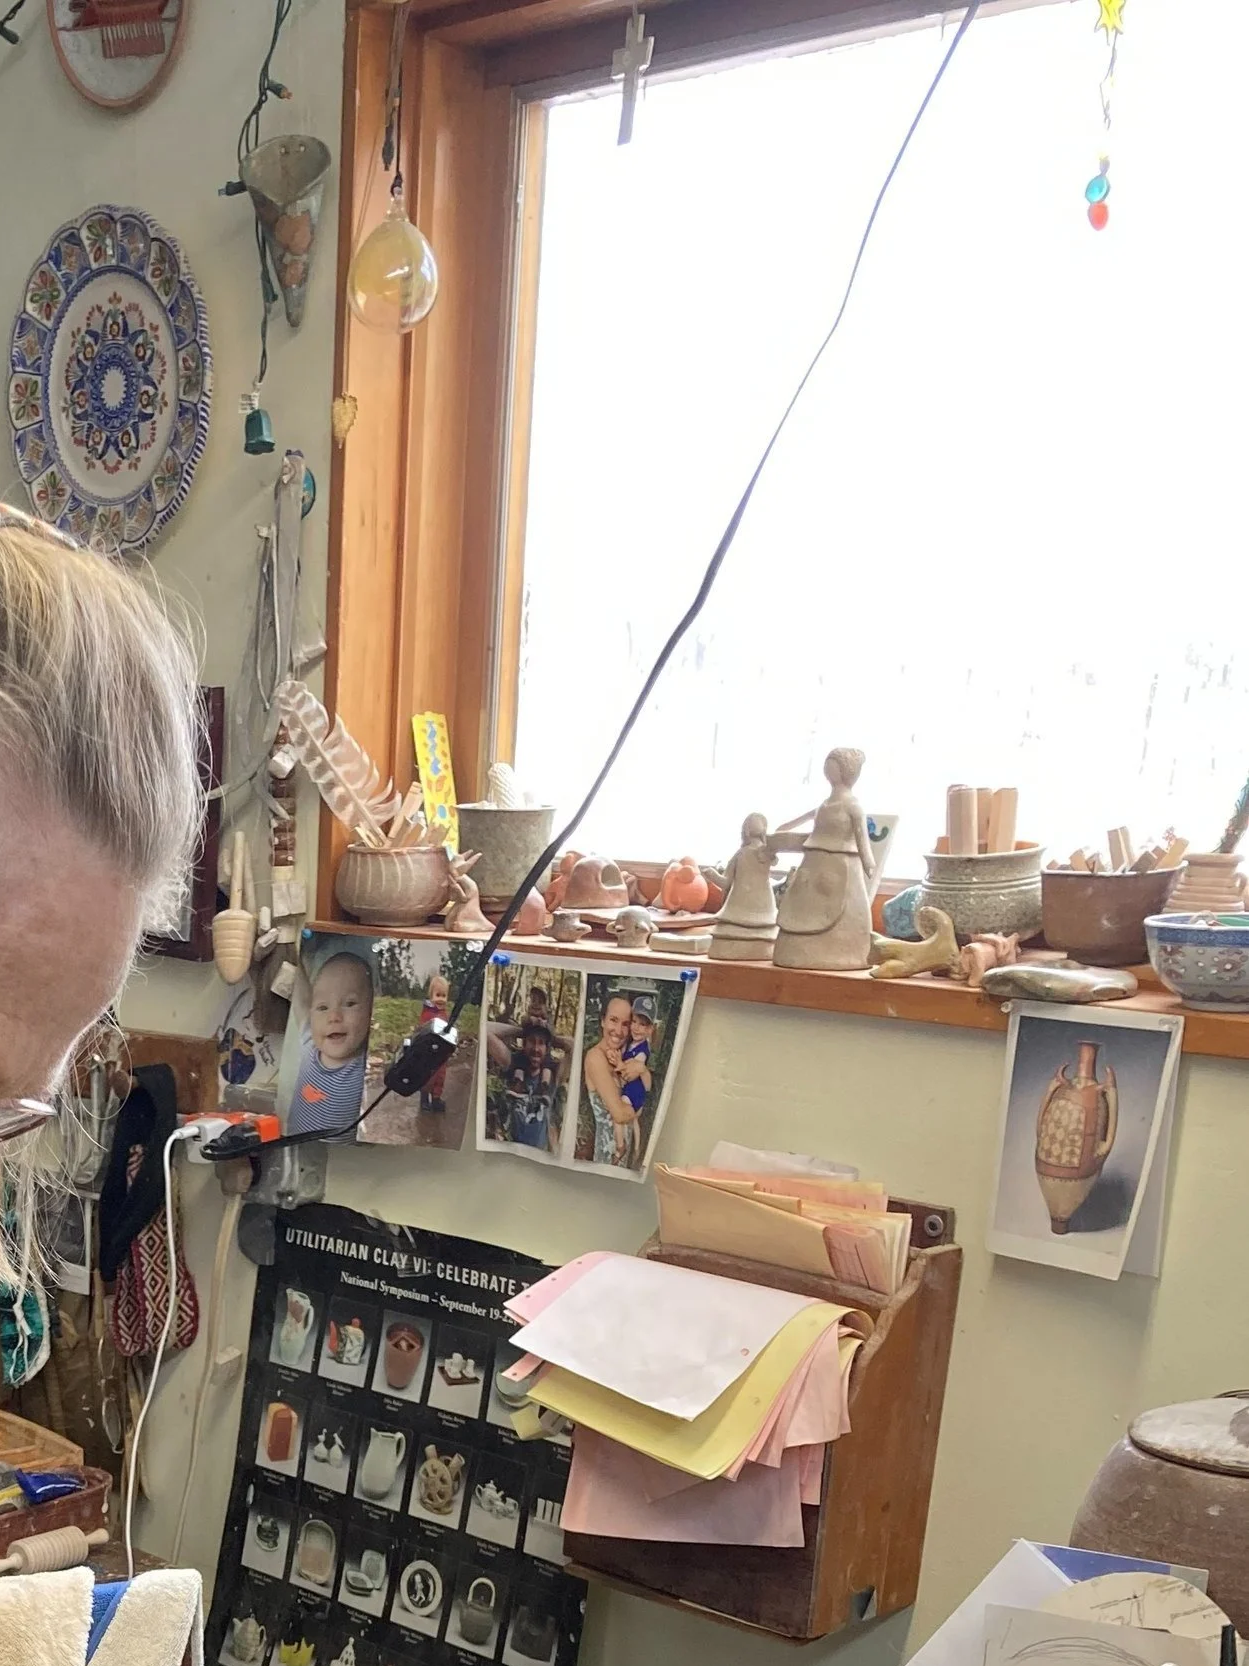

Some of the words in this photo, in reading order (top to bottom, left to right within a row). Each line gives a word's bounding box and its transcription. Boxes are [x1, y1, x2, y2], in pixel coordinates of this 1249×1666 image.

[285, 1227, 369, 1261] UTILITARIAN
[373, 1247, 408, 1269] CLAY
[413, 1257, 432, 1274] VI:
[436, 1261, 516, 1296] CELEBRATE
[340, 1270, 378, 1291] National
[379, 1280, 430, 1303] Symposium
[439, 1294, 487, 1317] September
